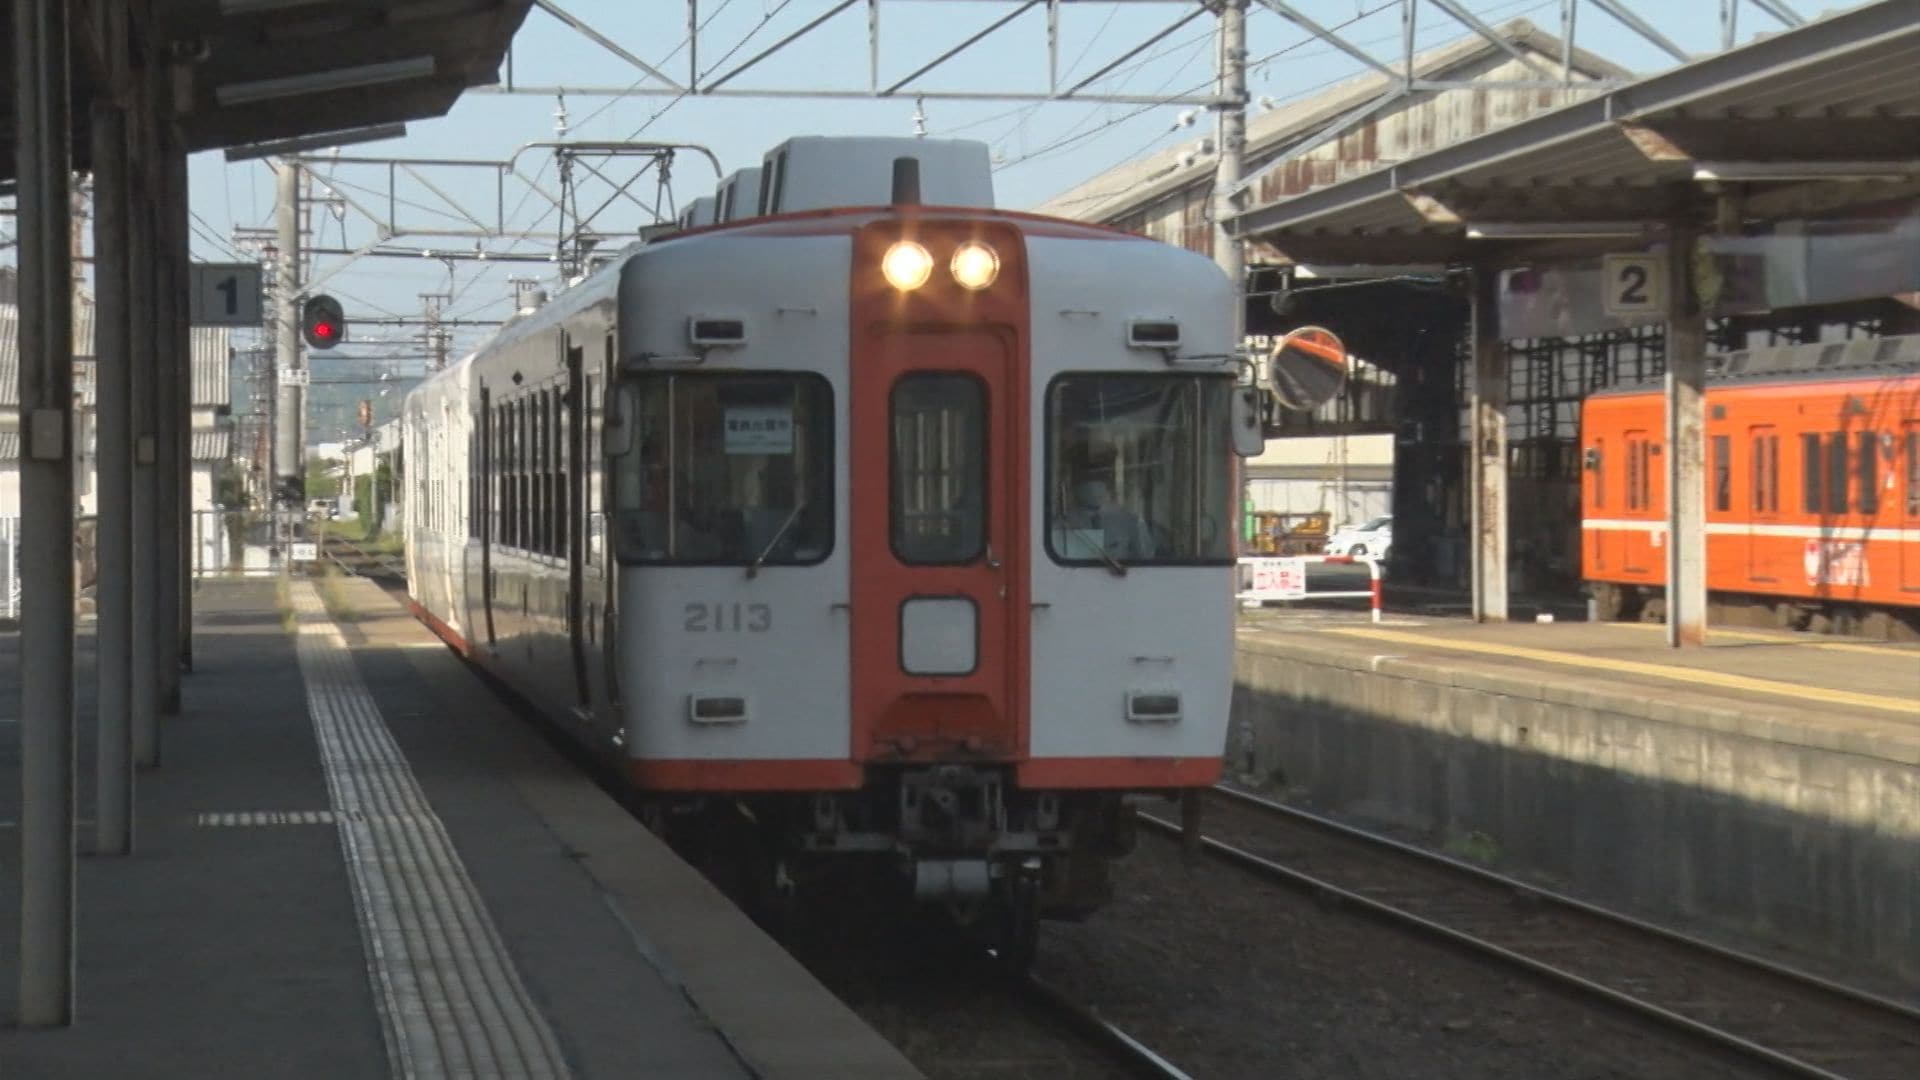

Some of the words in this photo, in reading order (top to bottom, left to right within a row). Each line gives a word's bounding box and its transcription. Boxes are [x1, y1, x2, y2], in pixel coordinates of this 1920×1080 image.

[216, 277, 237, 315] 1
[1619, 266, 1648, 304] 2
[684, 603, 771, 632] 2113
